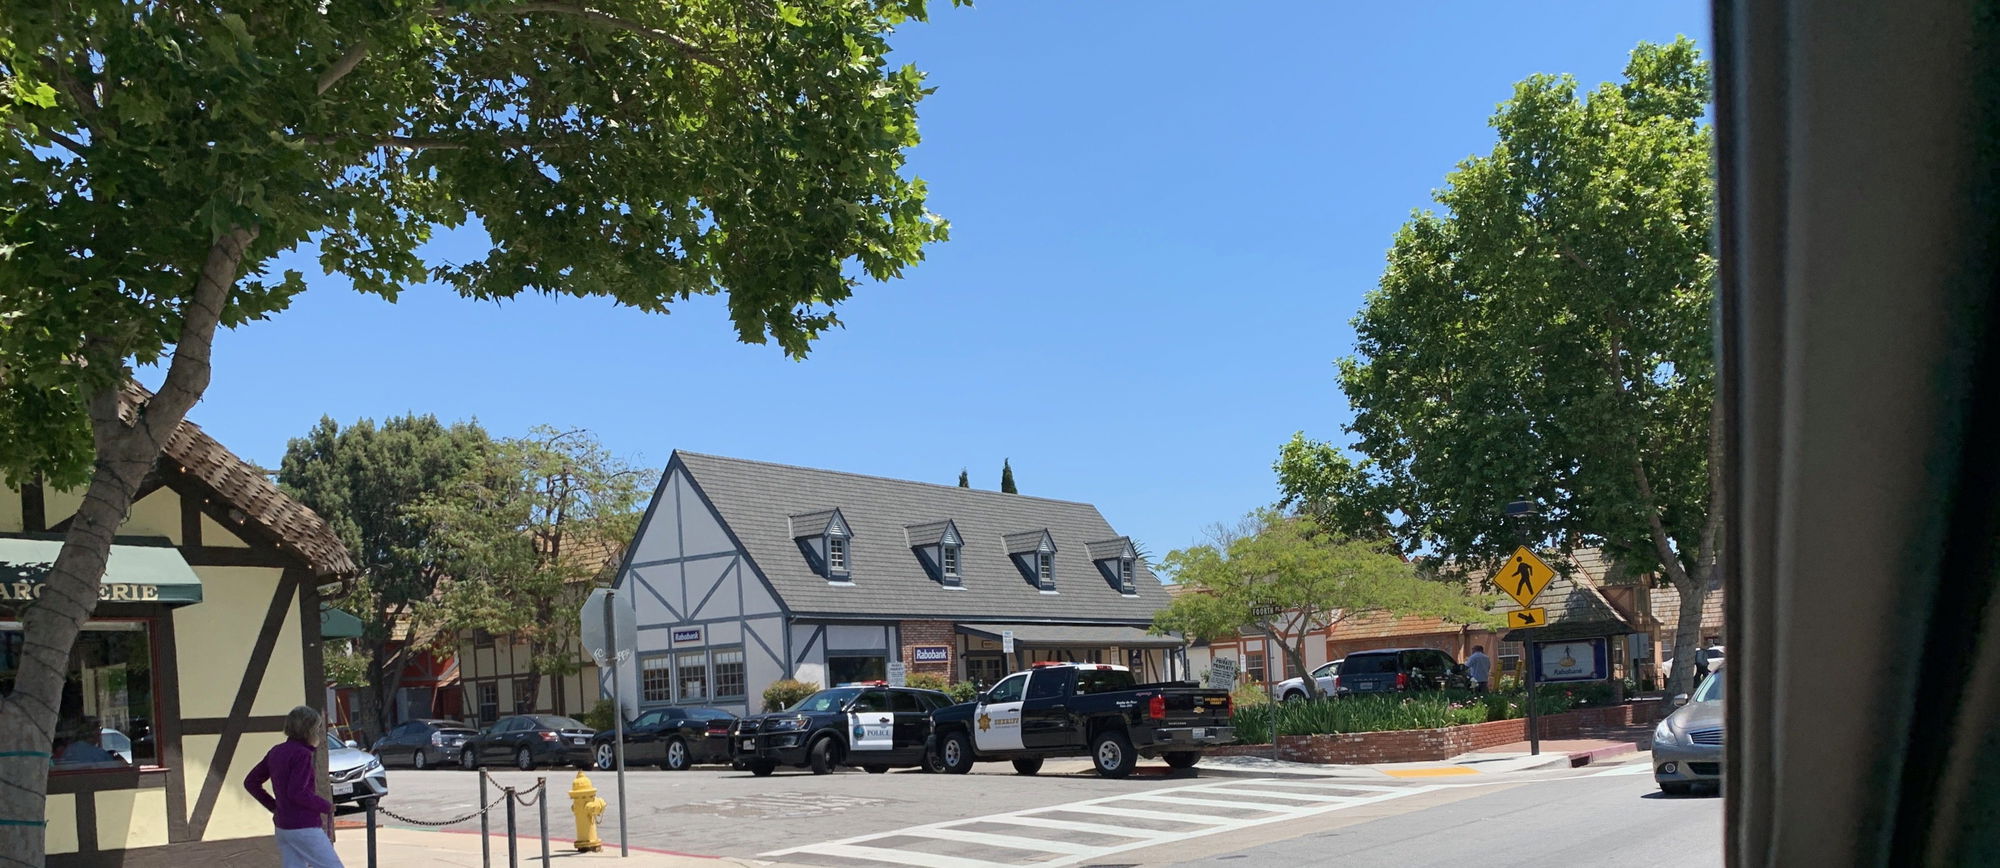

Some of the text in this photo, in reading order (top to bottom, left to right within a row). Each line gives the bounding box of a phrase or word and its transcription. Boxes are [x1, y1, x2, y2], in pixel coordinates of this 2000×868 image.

[675, 631, 699, 641] Rabobank
[916, 649, 947, 659] Rabobank
[994, 717, 1020, 725] SHERIFF
[867, 729, 890, 737] POLICE
